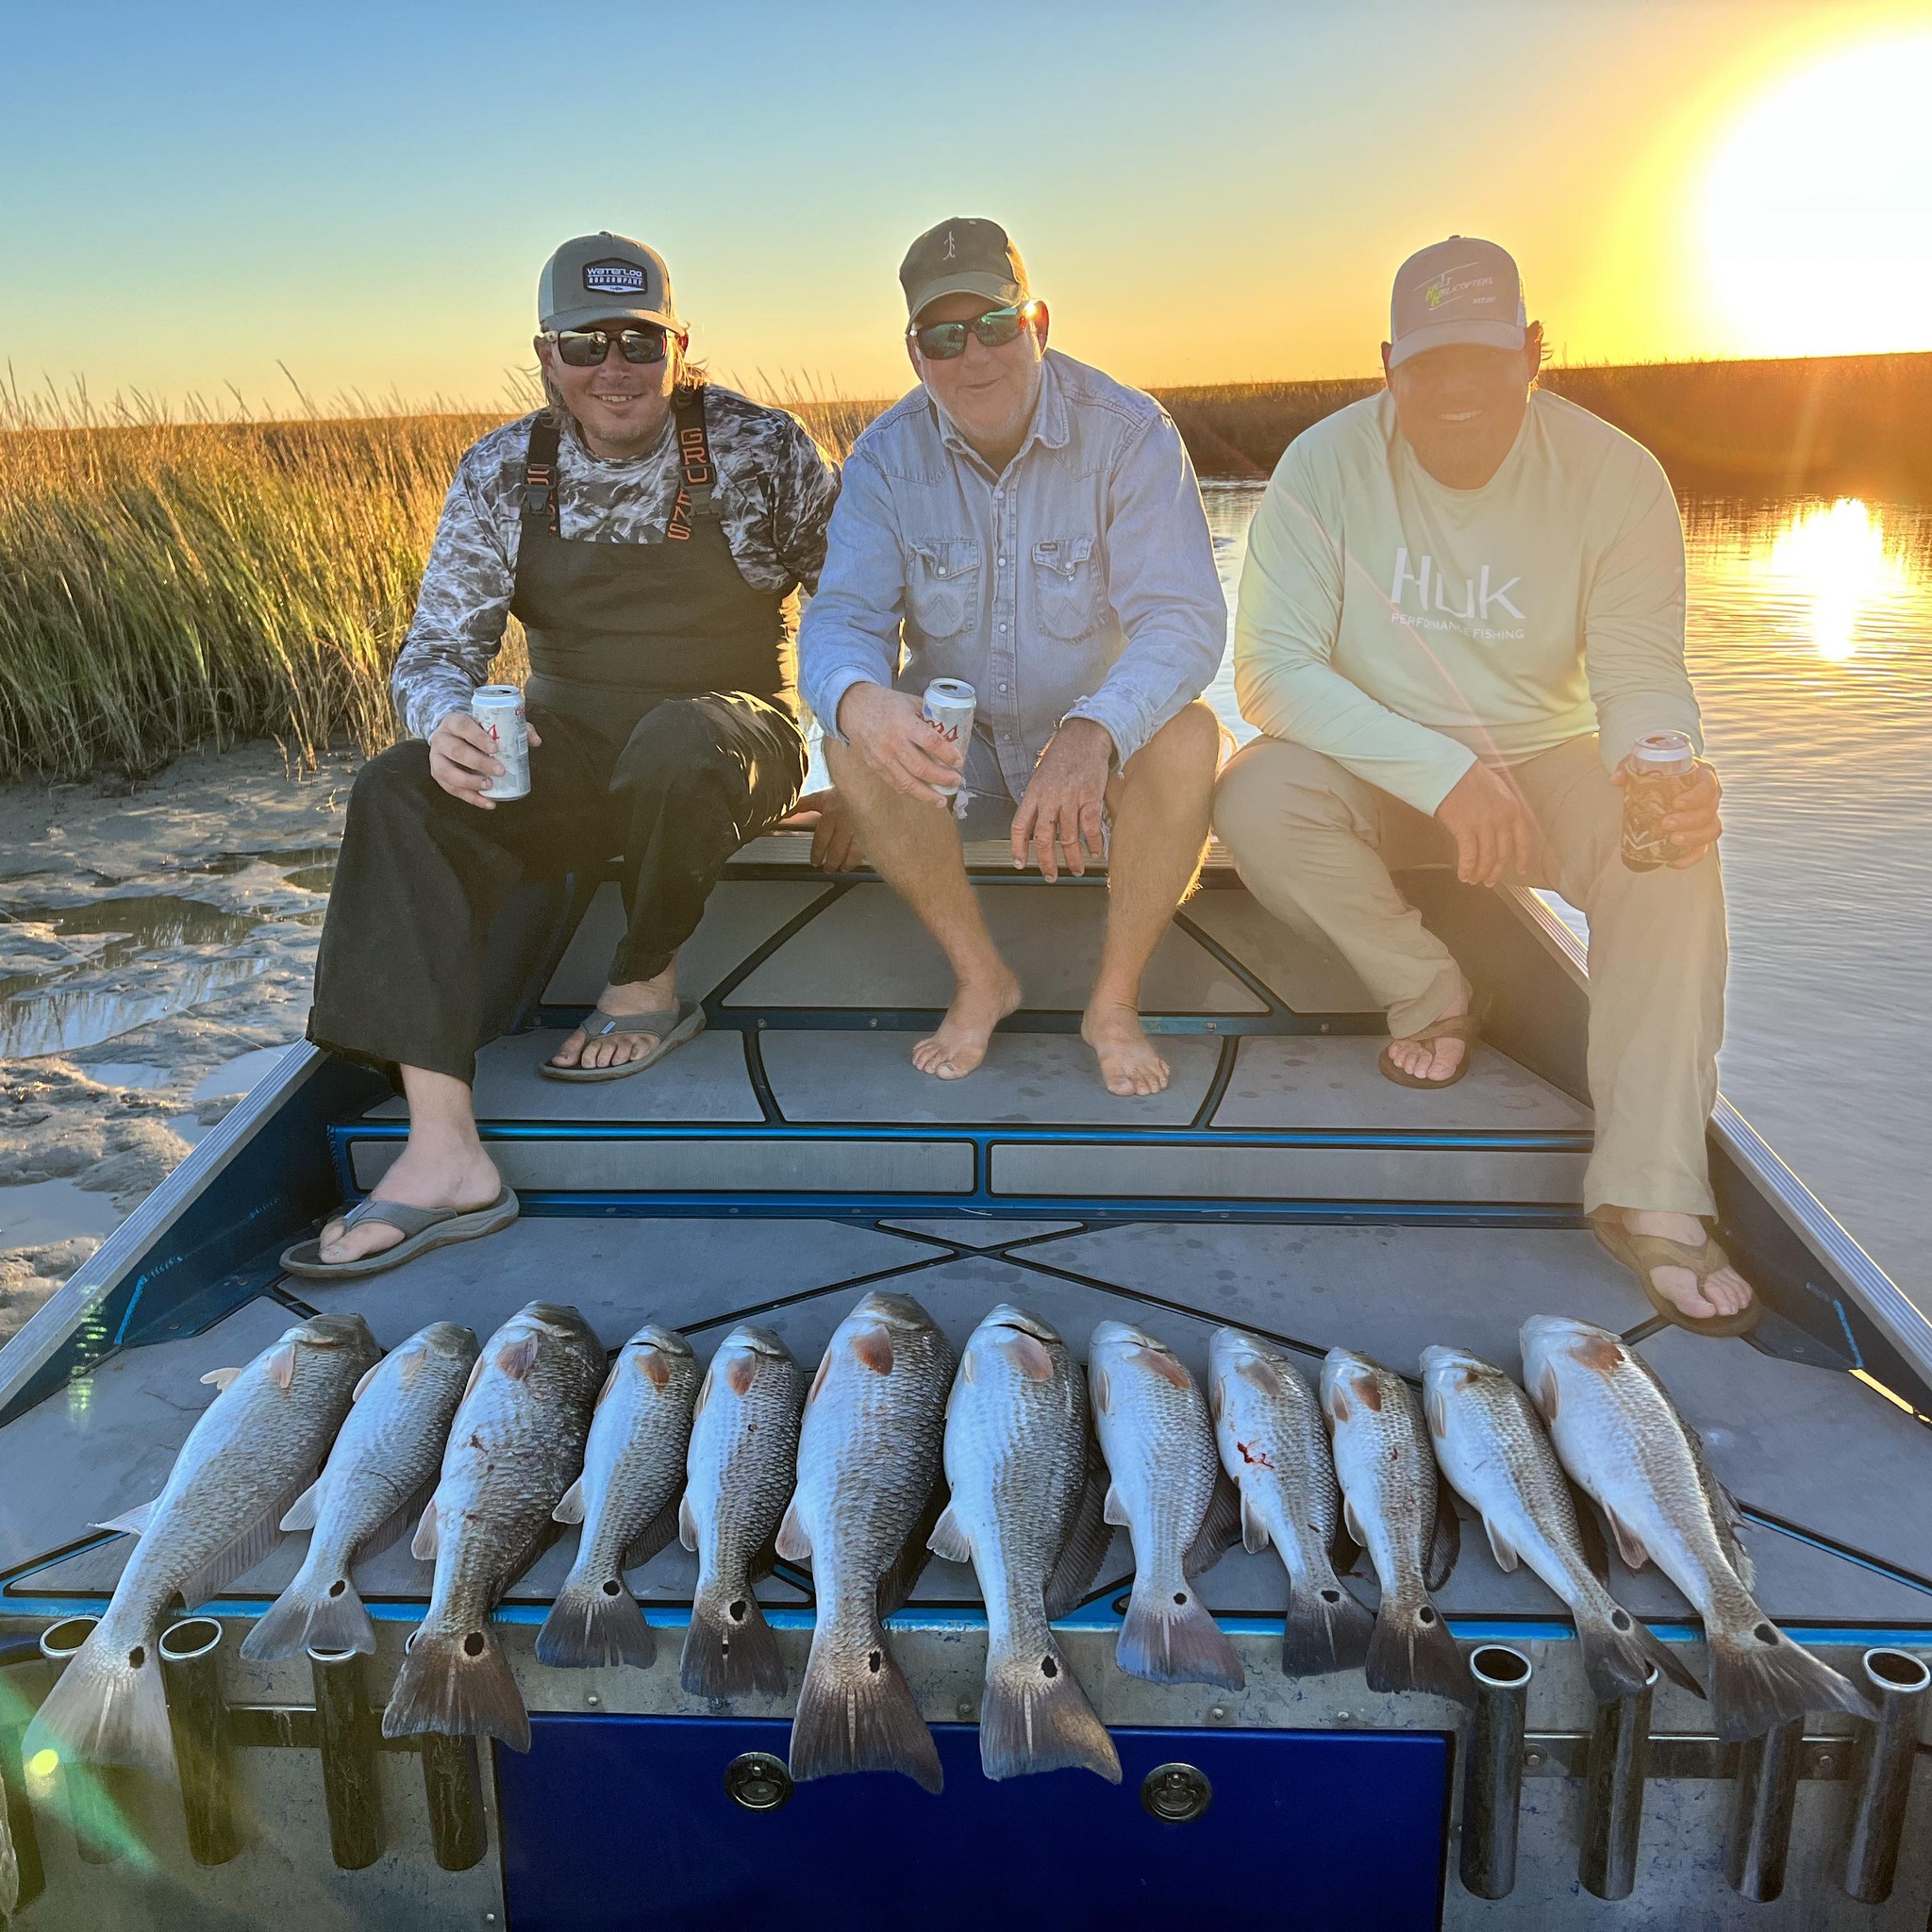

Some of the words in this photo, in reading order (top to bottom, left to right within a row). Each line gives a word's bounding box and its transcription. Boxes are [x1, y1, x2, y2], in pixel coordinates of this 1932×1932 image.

[606, 276, 643, 286] COMPANY
[1391, 613, 1472, 637] PERFOMANCE
[1472, 628, 1524, 641] FISHING
